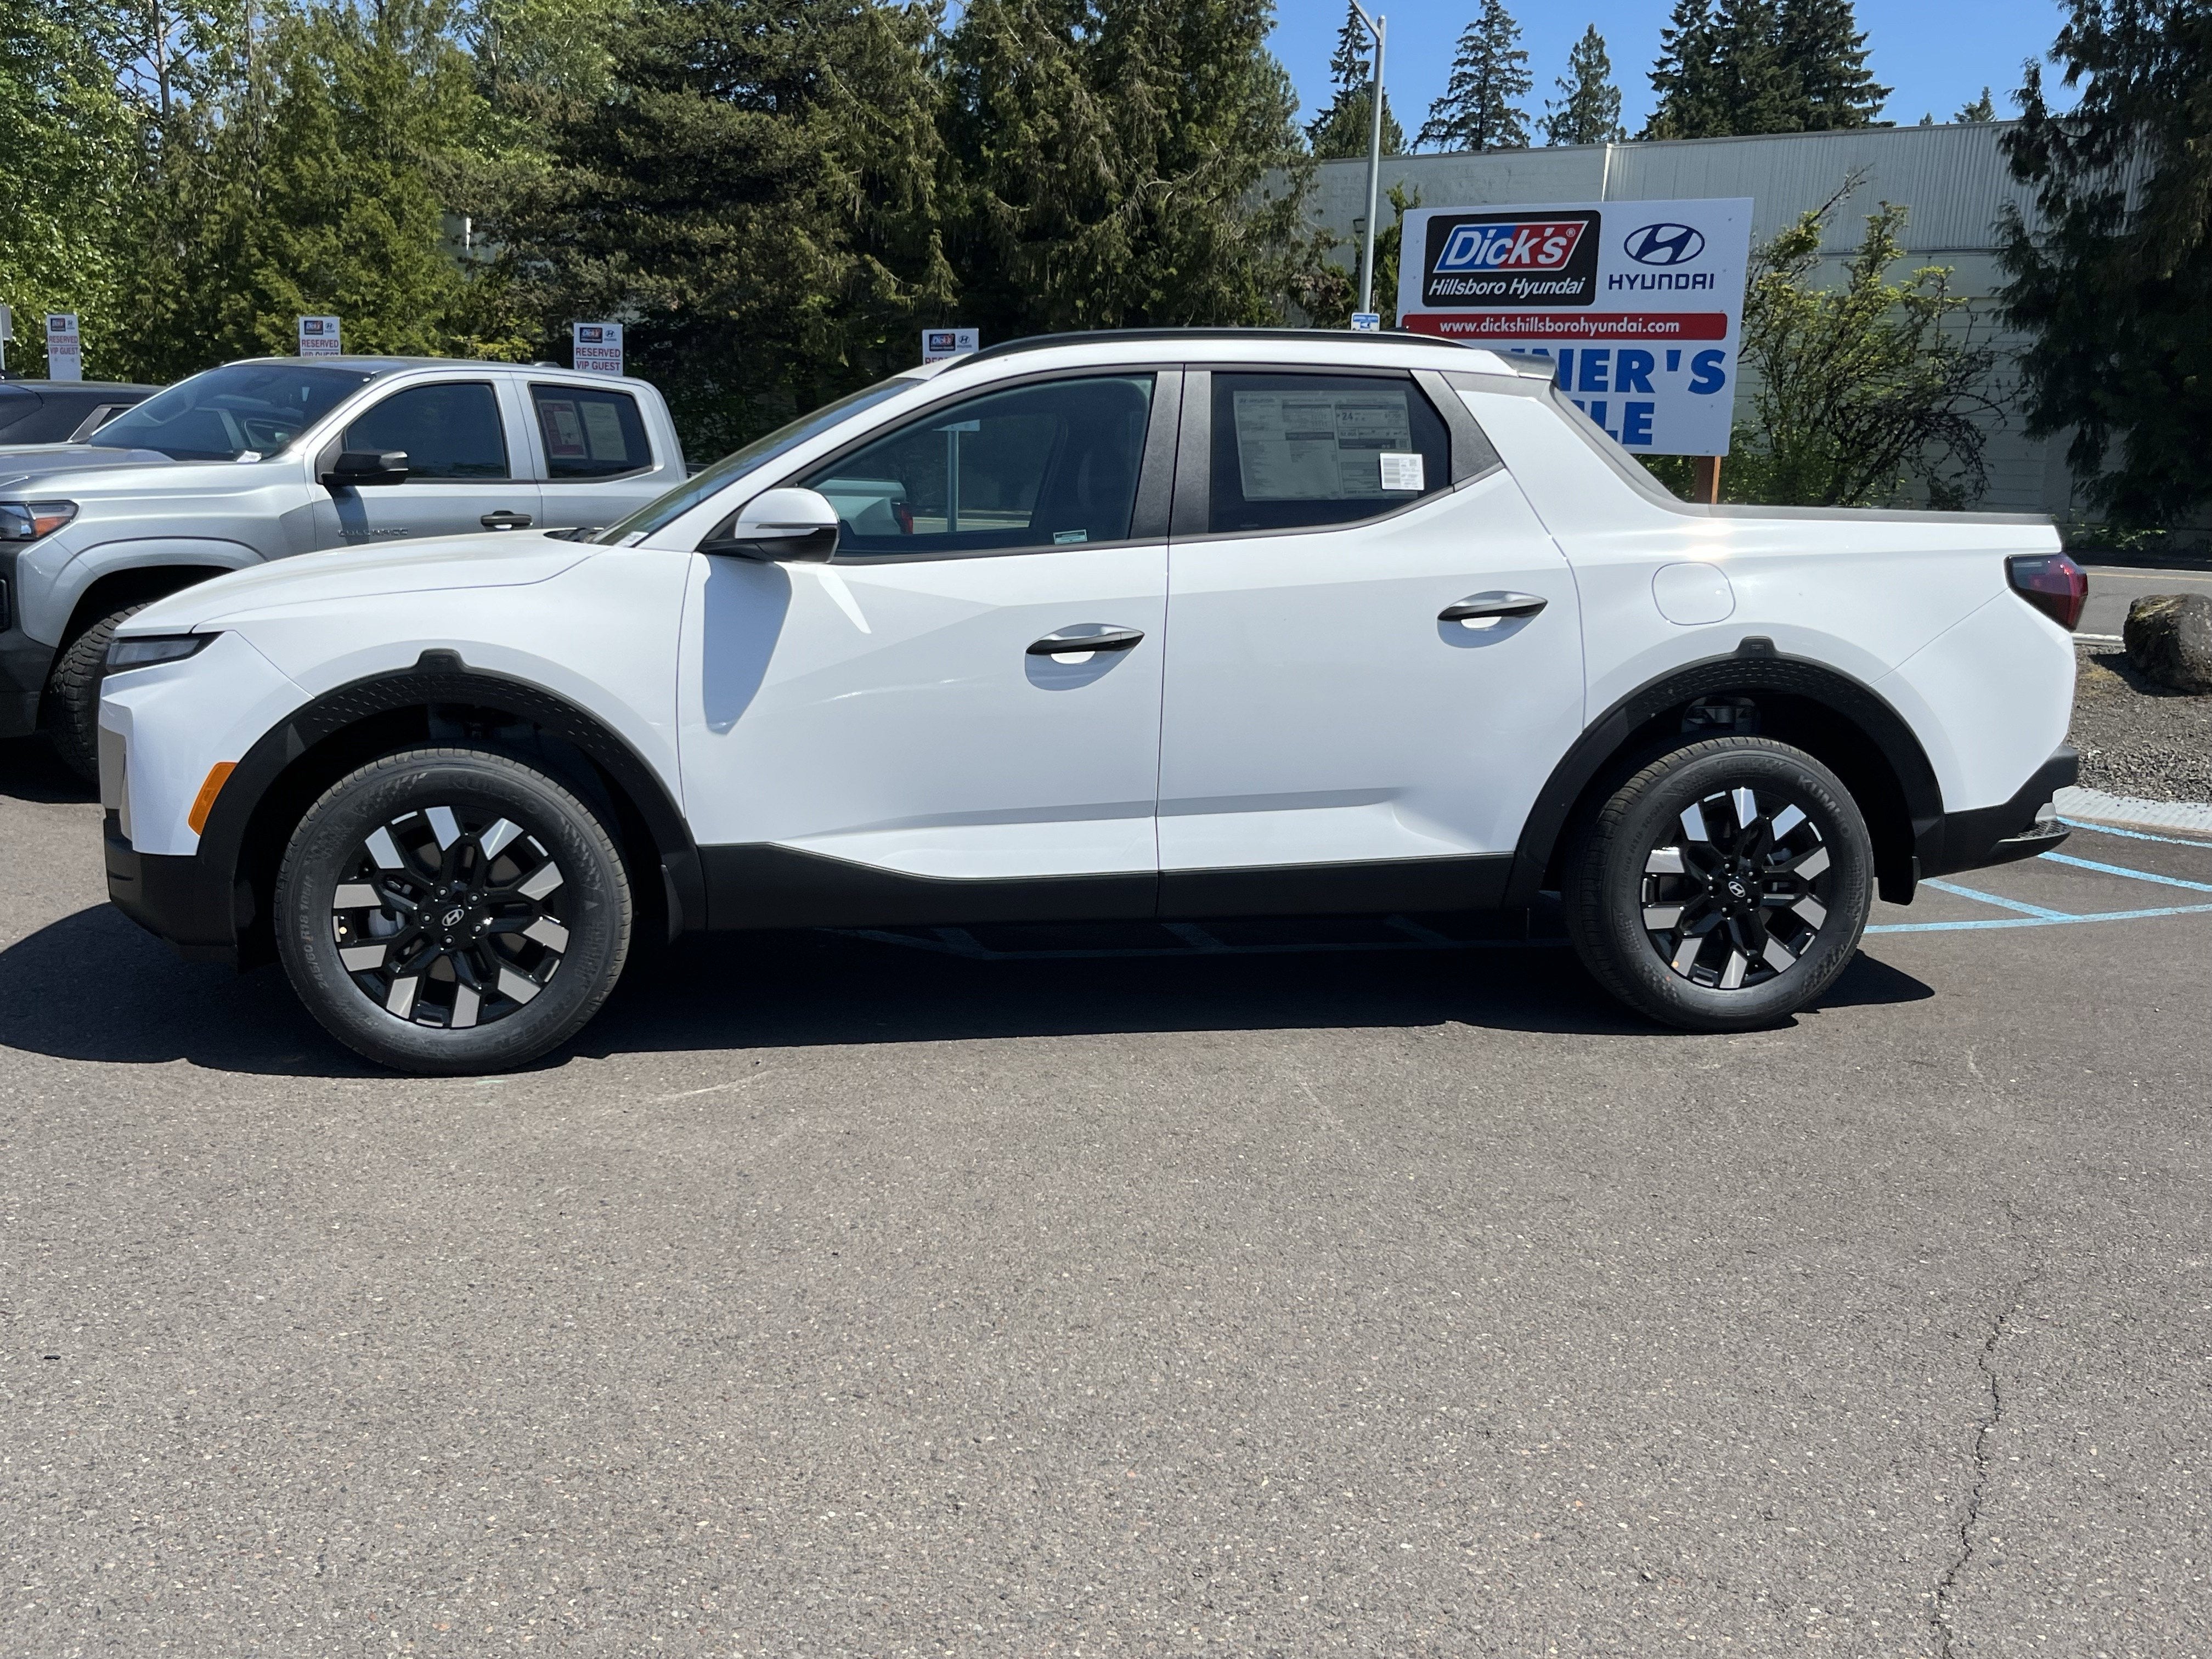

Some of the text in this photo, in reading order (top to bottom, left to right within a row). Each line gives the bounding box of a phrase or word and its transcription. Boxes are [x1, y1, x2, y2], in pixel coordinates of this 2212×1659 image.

[1445, 227, 1567, 266] Dick's
[1608, 273, 1715, 290] HYUNDAI
[1428, 276, 1586, 299] Hillsboro Hyundai
[1439, 317, 1680, 337] www.dickshillsborohyundai.com
[48, 335, 78, 343] RESERVED
[301, 339, 339, 348] RESERVED
[49, 347, 78, 355] VIP GUEST
[575, 347, 620, 358] RESERVED
[576, 360, 620, 371] VIP GUEST
